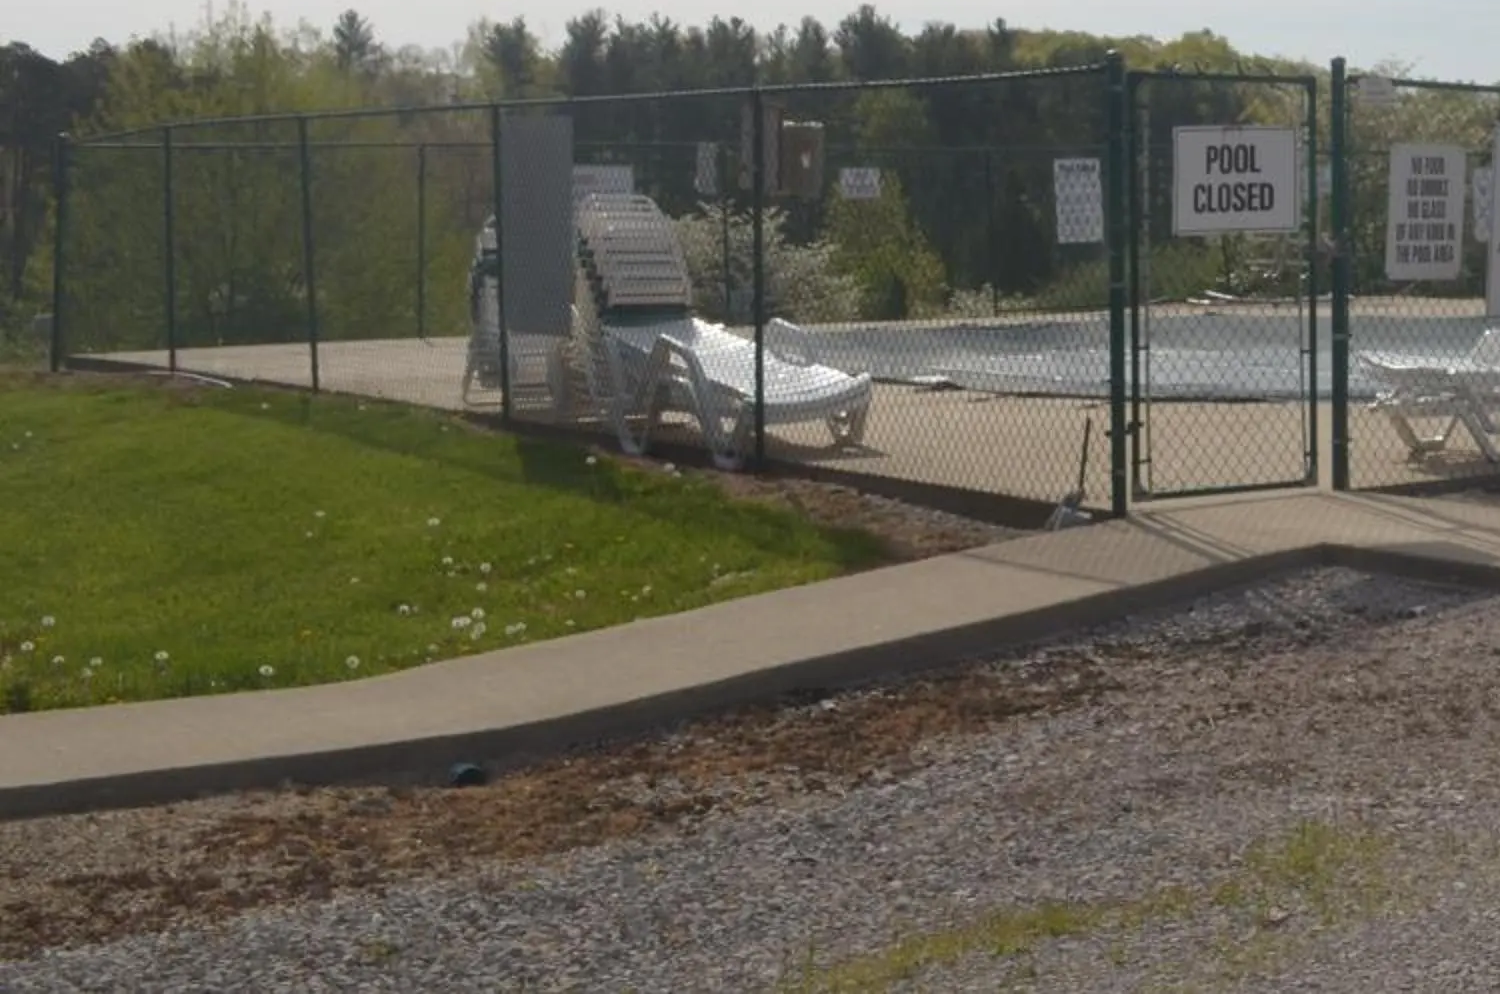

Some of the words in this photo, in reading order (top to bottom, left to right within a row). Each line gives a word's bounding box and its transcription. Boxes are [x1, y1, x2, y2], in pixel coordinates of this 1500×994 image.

[1206, 144, 1262, 175] POOL
[1411, 157, 1422, 175] NO
[1193, 182, 1275, 214] CLOSED
